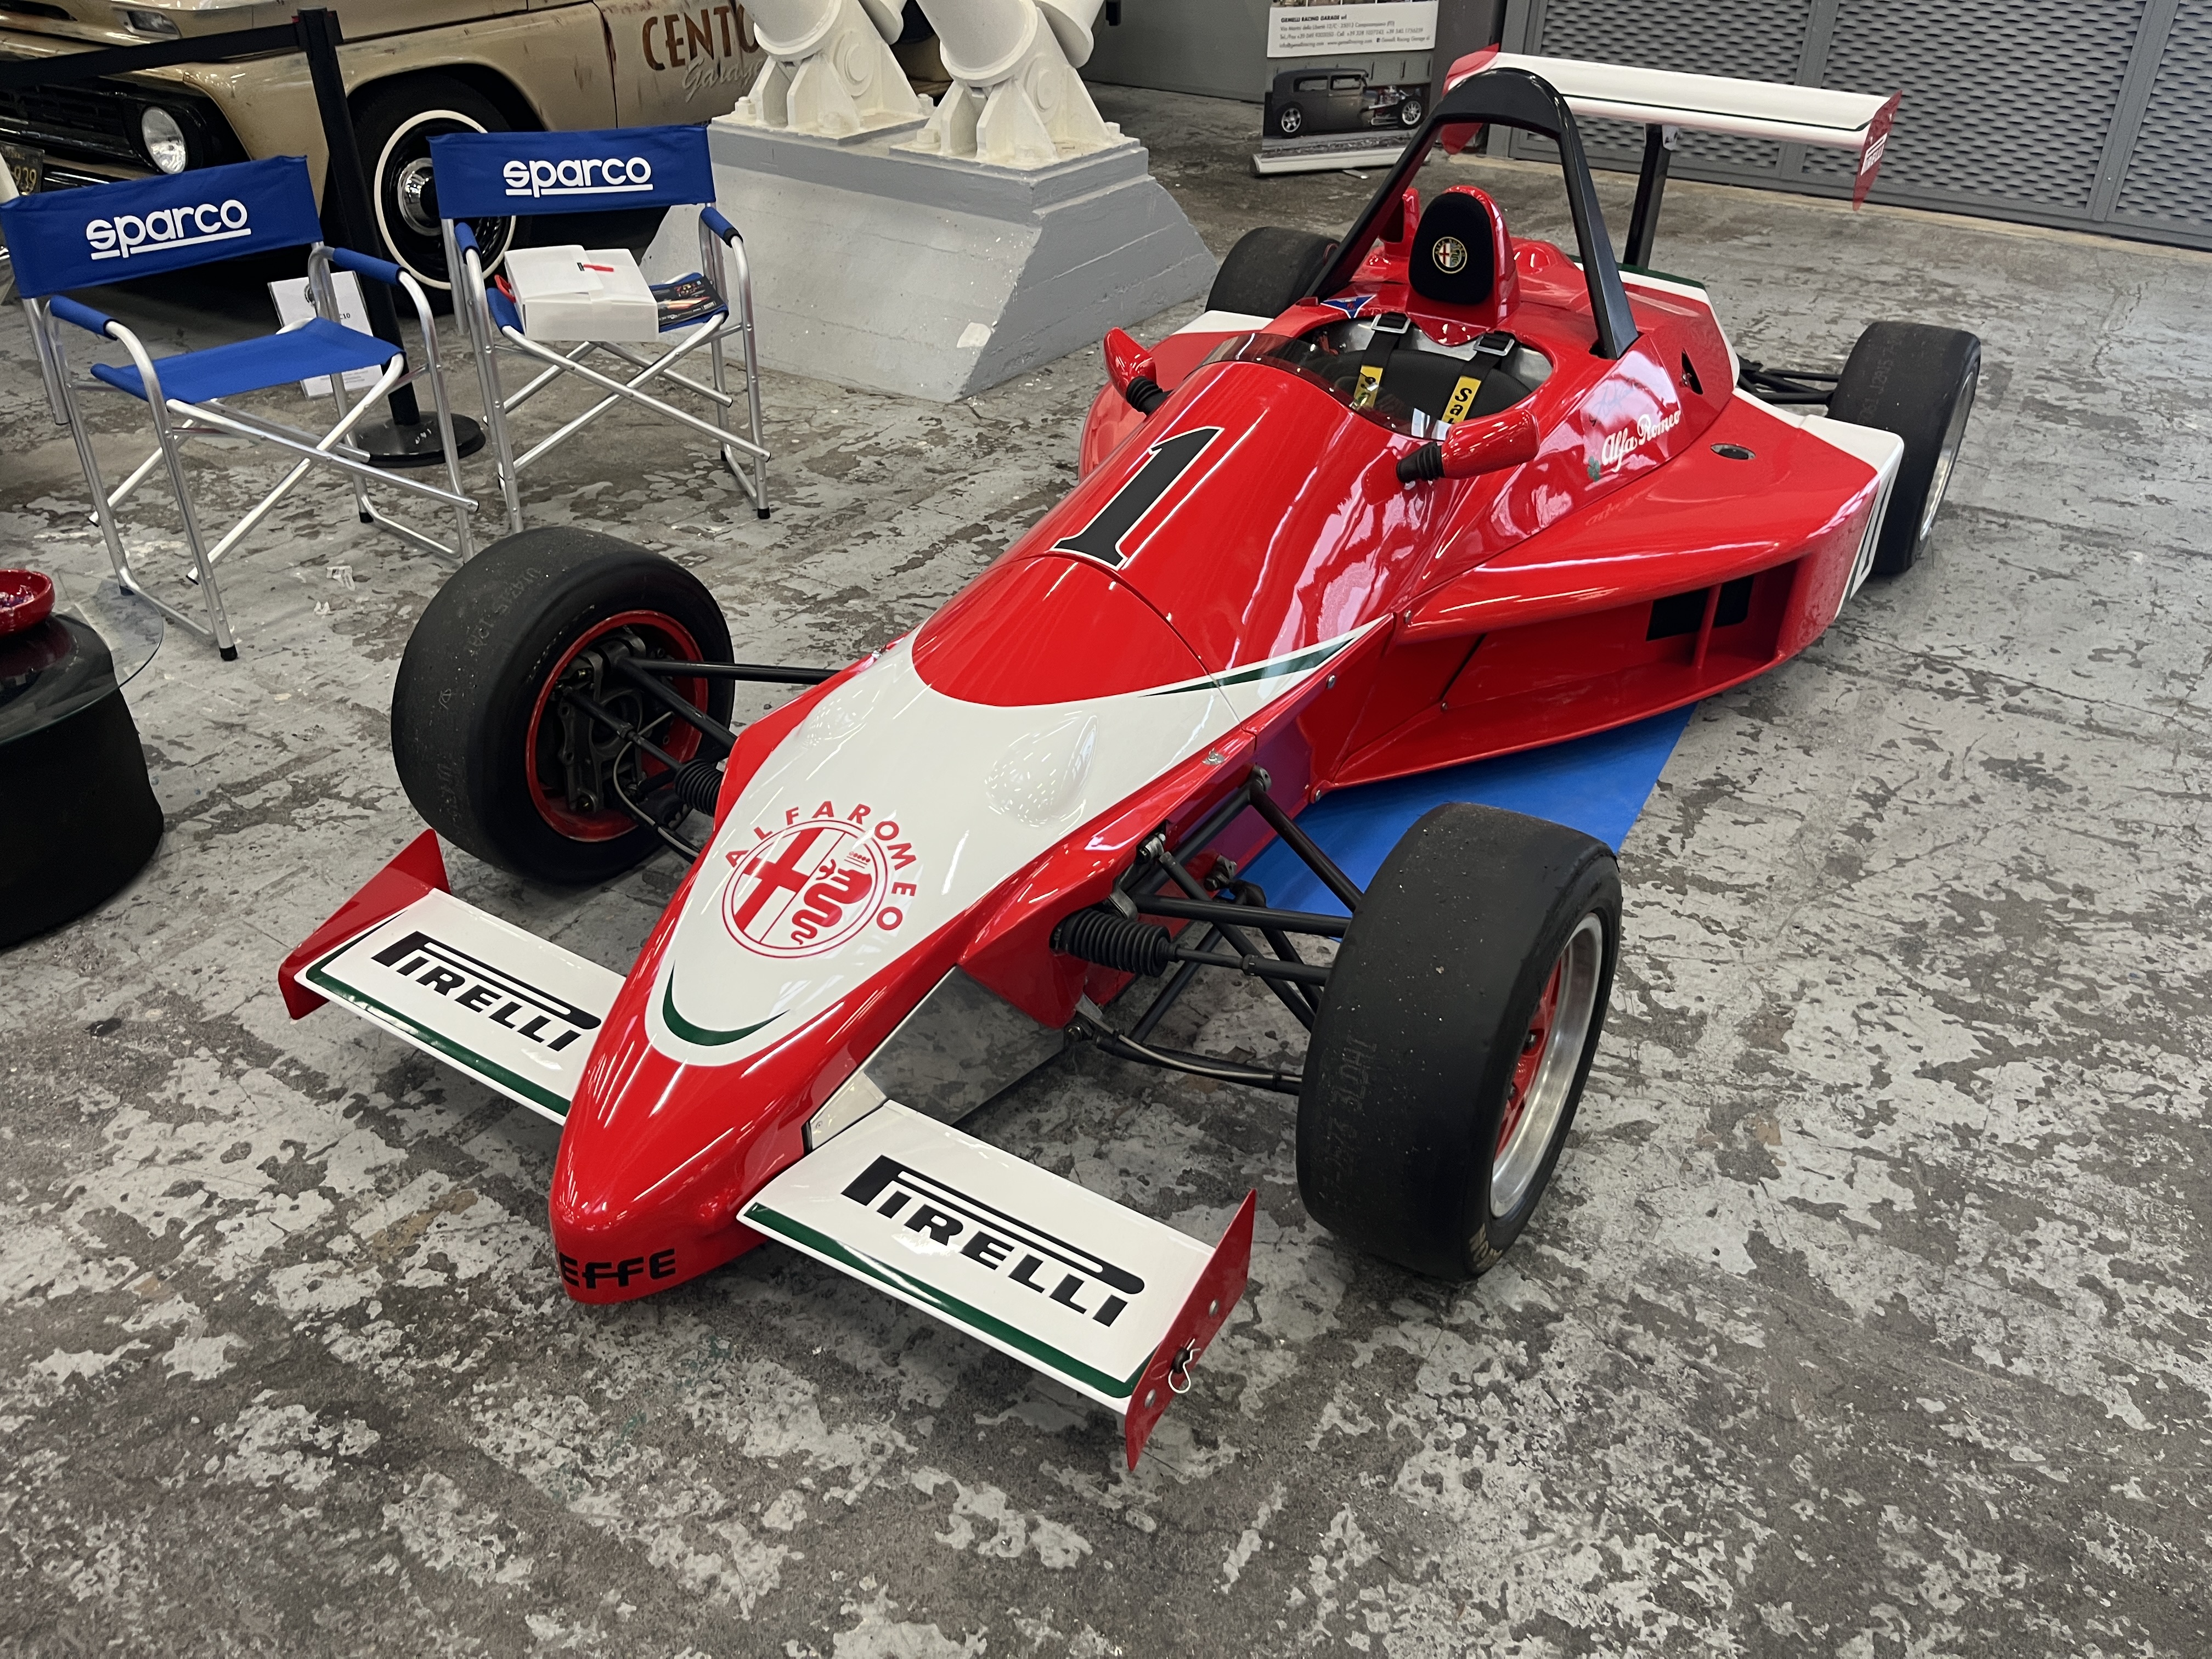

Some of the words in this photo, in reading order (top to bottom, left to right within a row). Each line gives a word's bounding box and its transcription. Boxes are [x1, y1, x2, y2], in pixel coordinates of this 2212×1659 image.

[503, 156, 653, 198] sparco
[86, 199, 252, 258] sparco
[1447, 388, 1472, 424] Sa
[1601, 427, 1638, 472] Alfa
[1637, 410, 1681, 445] Romeo
[1051, 426, 1224, 570] 1
[371, 930, 601, 1052] PIRELLI
[842, 1154, 1145, 1327] PIRELLI
